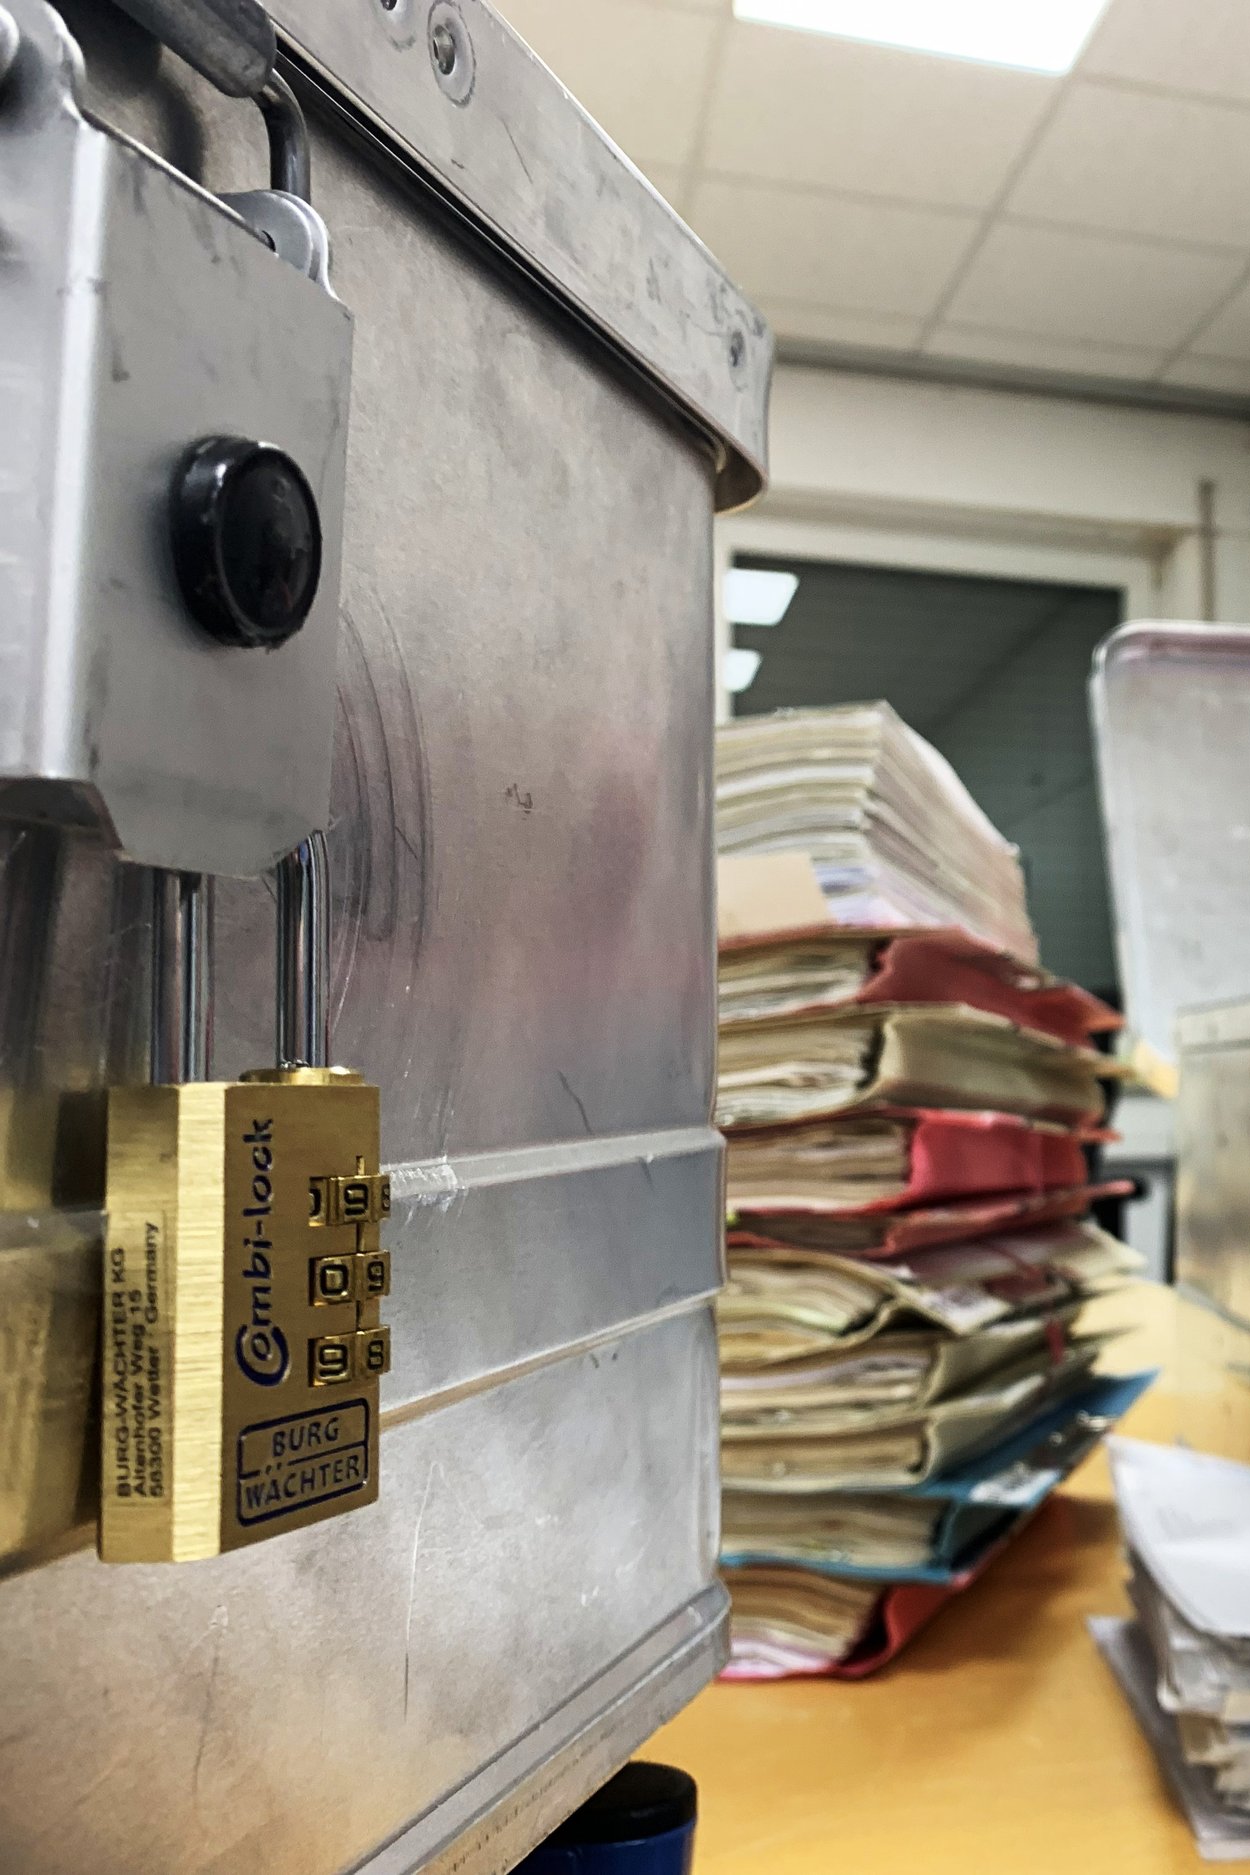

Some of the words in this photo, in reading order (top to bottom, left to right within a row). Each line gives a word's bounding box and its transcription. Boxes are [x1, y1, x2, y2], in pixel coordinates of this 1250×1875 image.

[343, 1183, 368, 1217] 9
[110, 1247, 126, 1283] KG
[144, 1221, 160, 1324] Germany
[234, 1118, 290, 1387] Combi-lock
[130, 1324, 146, 1376] Weg
[319, 1344, 348, 1377] 9
[367, 1340, 384, 1370] 8
[147, 1345, 161, 1420] Wetter
[131, 1381, 147, 1498] Altenhofer
[272, 1416, 340, 1457] BURG
[245, 1455, 361, 1510] WÄCHTER
